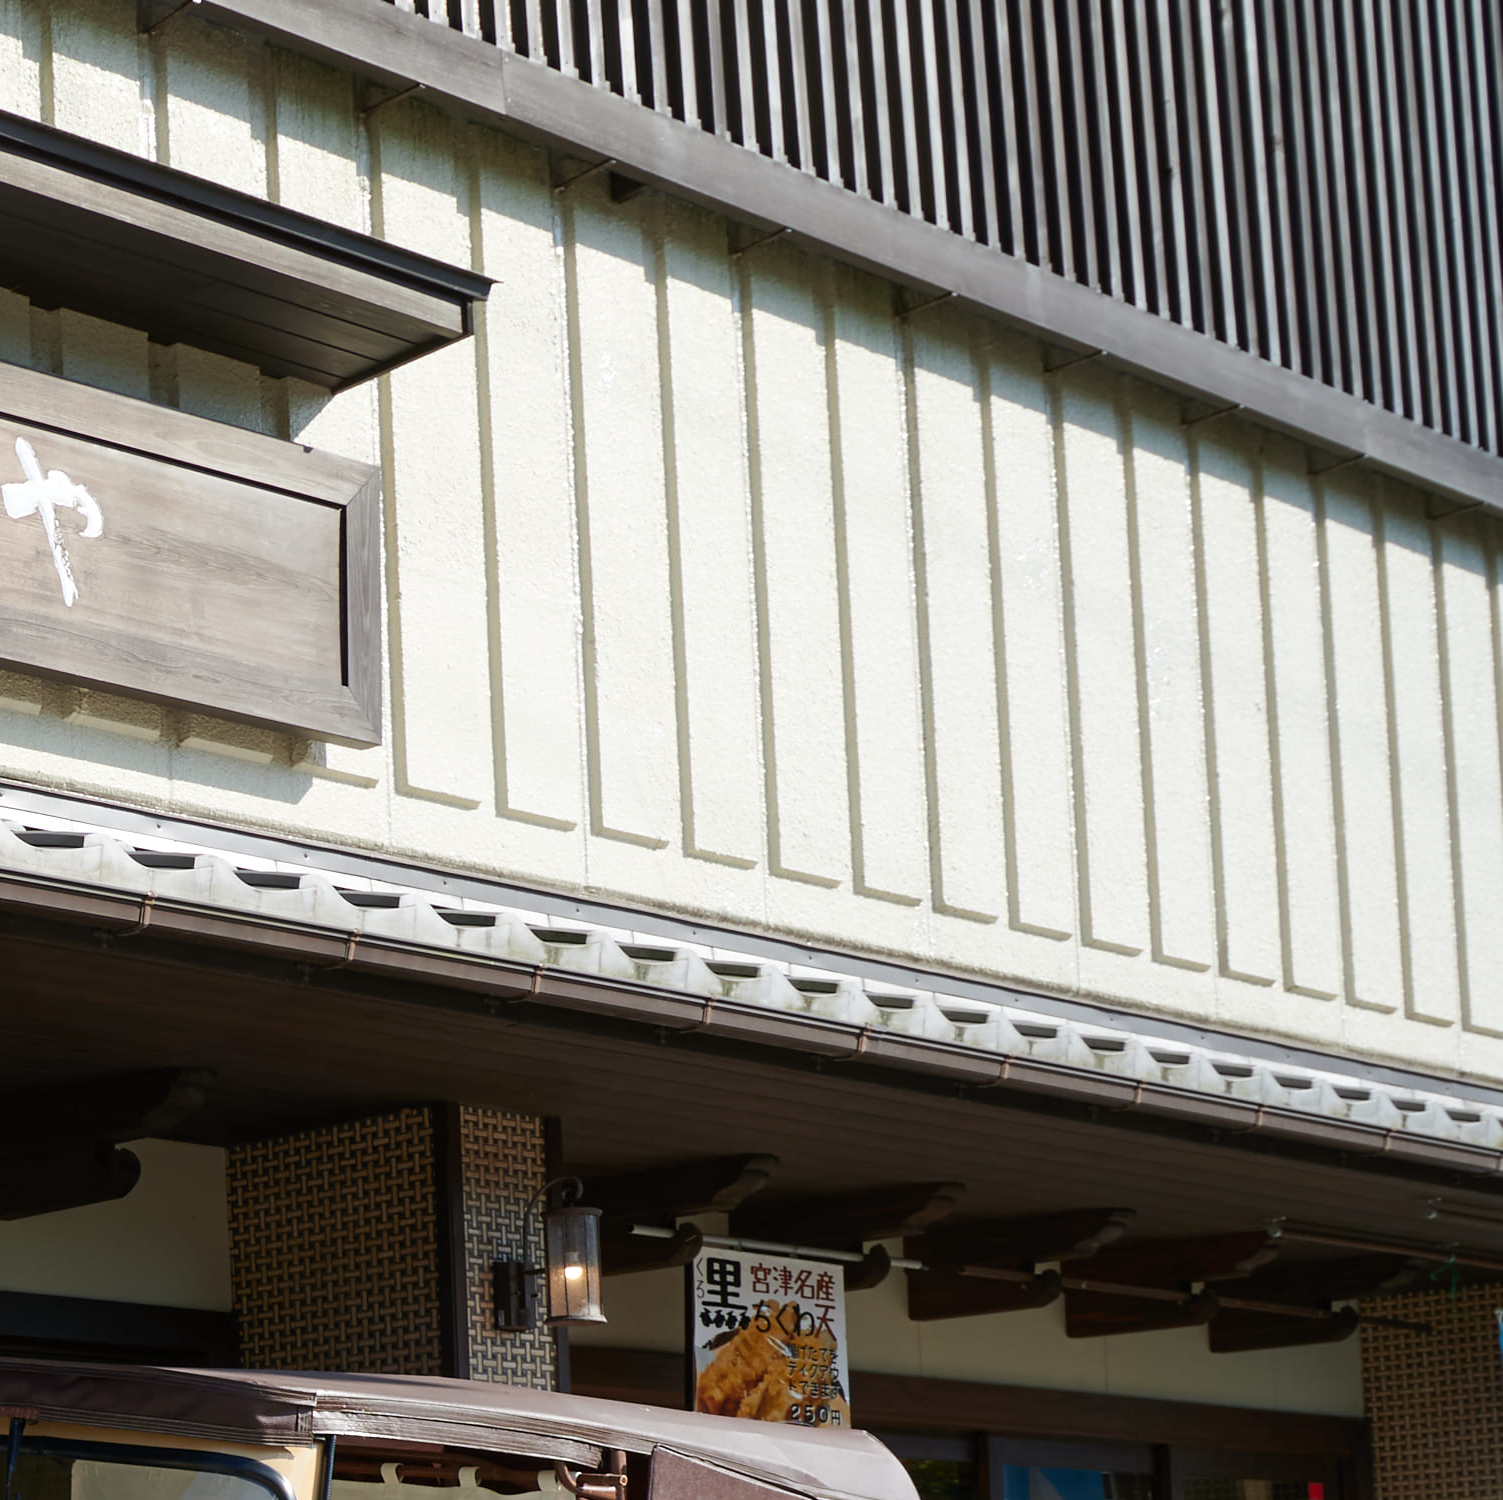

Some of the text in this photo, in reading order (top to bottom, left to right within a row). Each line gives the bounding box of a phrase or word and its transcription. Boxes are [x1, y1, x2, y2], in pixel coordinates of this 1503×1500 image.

[750, 1262, 836, 1302] 宮津名産
[752, 1299, 837, 1342] ちくわ天
[791, 1403, 841, 1426] 250円
